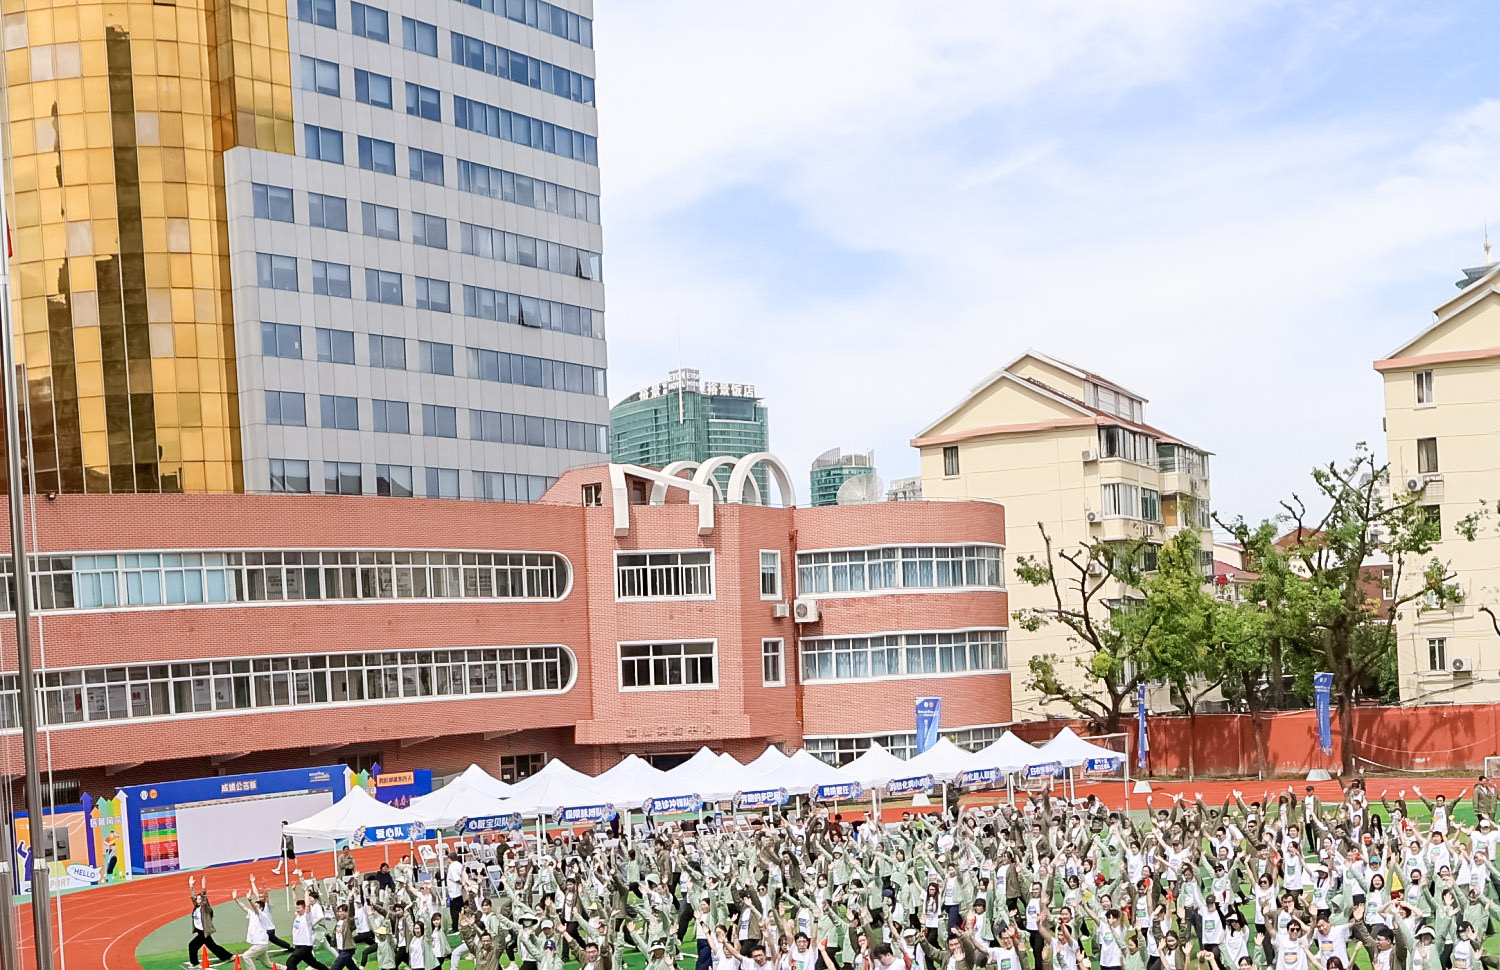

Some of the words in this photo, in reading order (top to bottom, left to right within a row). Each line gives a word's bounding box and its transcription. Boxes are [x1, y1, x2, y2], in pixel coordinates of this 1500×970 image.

[707, 381, 755, 397] 裕景饭店
[375, 826, 404, 840] 爱心队
[74, 867, 96, 879] HELLO
